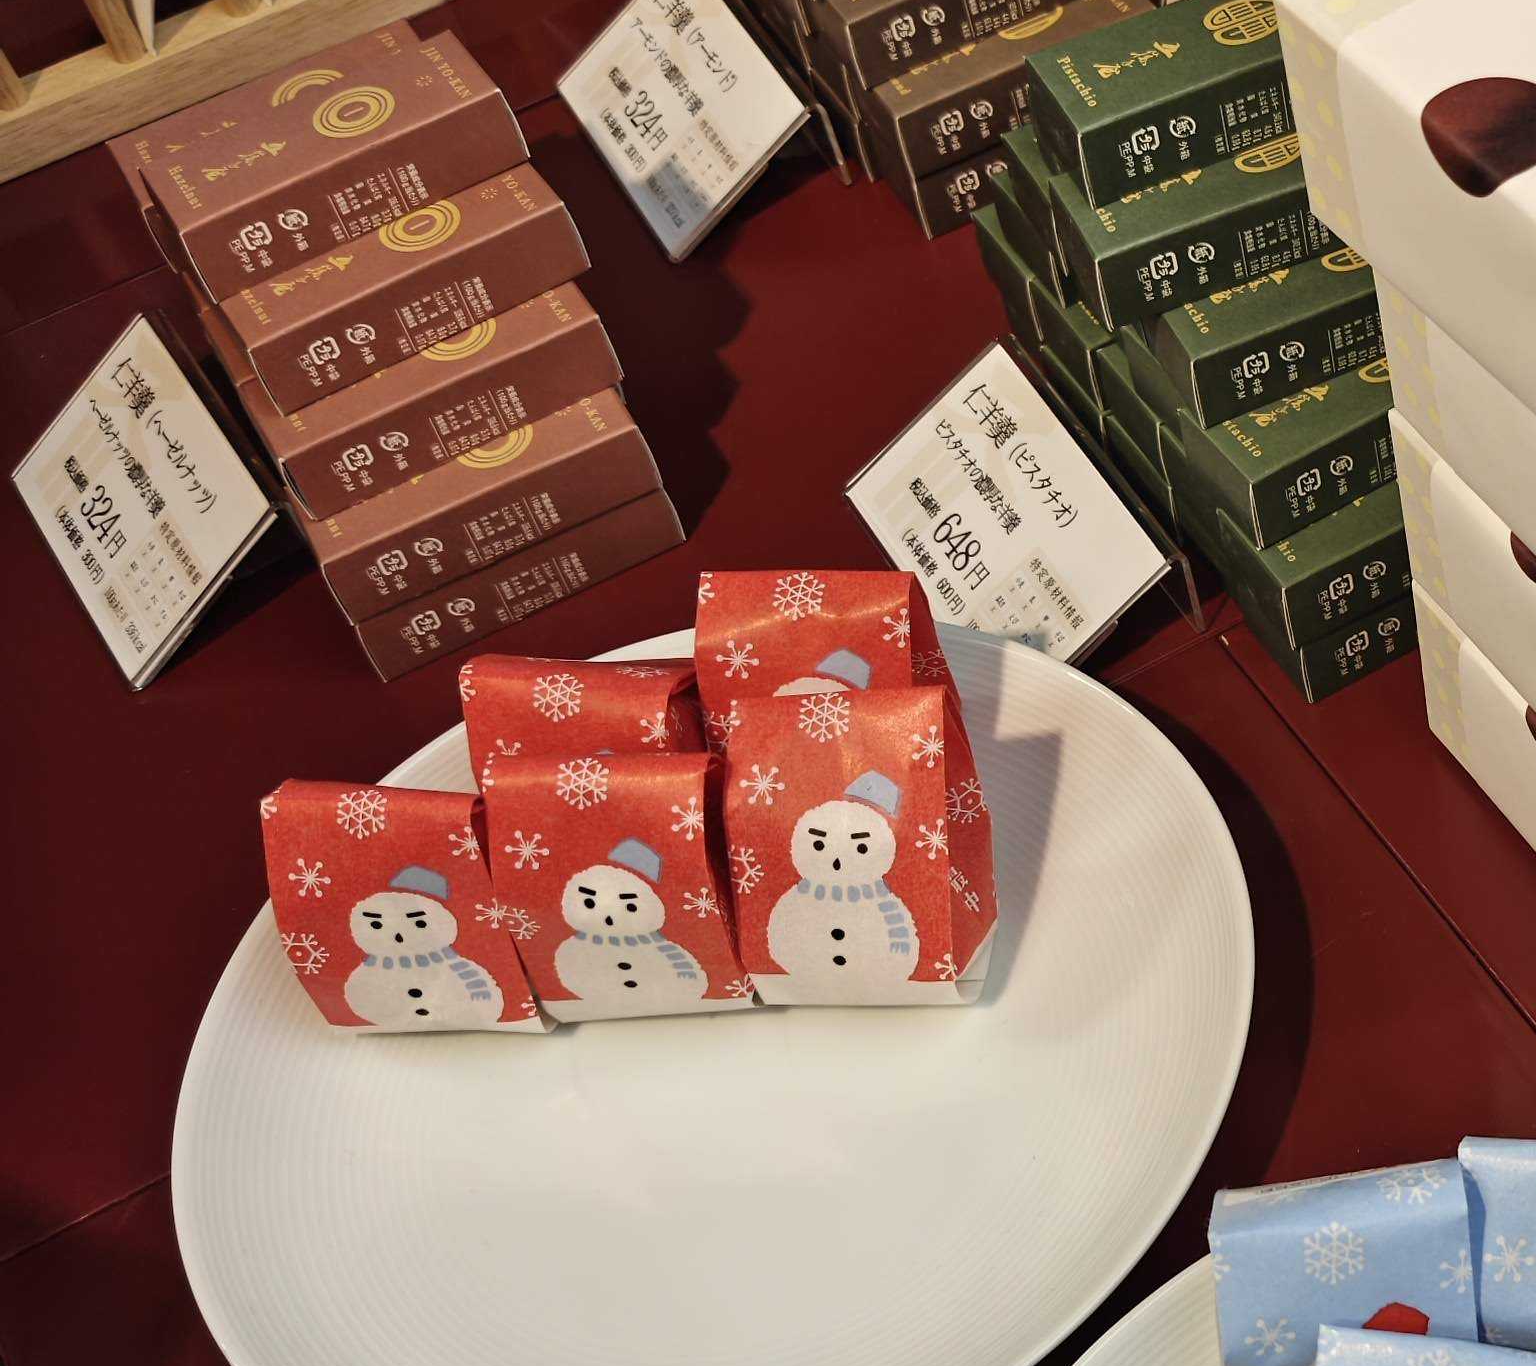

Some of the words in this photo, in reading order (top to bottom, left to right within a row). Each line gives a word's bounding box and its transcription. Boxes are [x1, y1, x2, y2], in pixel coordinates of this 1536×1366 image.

[1057, 53, 1098, 109] Pistachio
[962, 383, 1019, 450] 仁羊羹
[908, 476, 944, 521] 税込価格
[934, 418, 1025, 536] ピスタチオの濃厚な羊羹
[1028, 557, 1088, 632] 特定原材料情報
